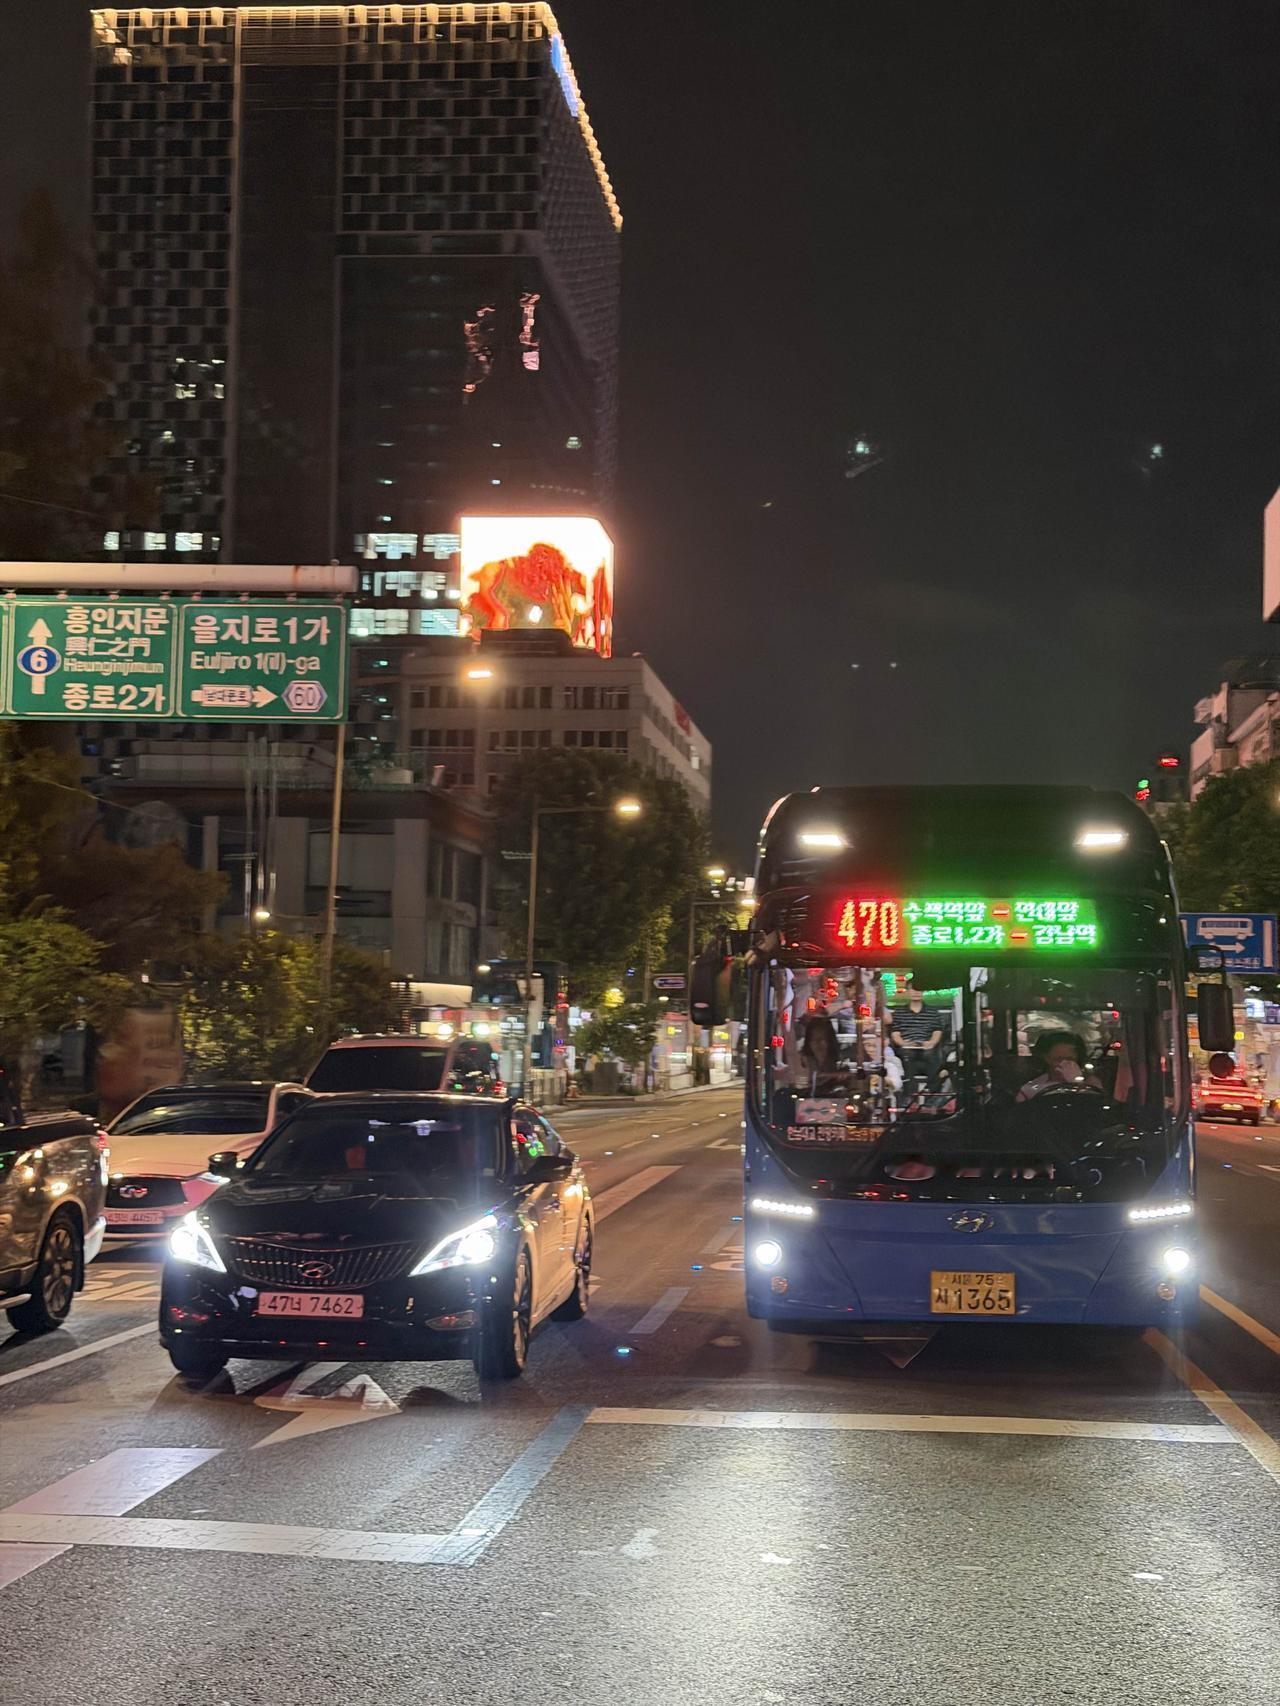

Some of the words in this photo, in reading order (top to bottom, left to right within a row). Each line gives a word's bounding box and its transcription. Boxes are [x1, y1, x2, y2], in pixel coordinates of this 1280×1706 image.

[63, 606, 170, 635] 흥인지문
[190, 615, 331, 646] 을지로1가
[29, 649, 49, 672] 6
[62, 682, 166, 712] 종로2가
[294, 686, 316, 706] 60
[837, 900, 899, 947] 470
[1032, 924, 1097, 945] 강남역
[309, 1296, 355, 1315] 7462
